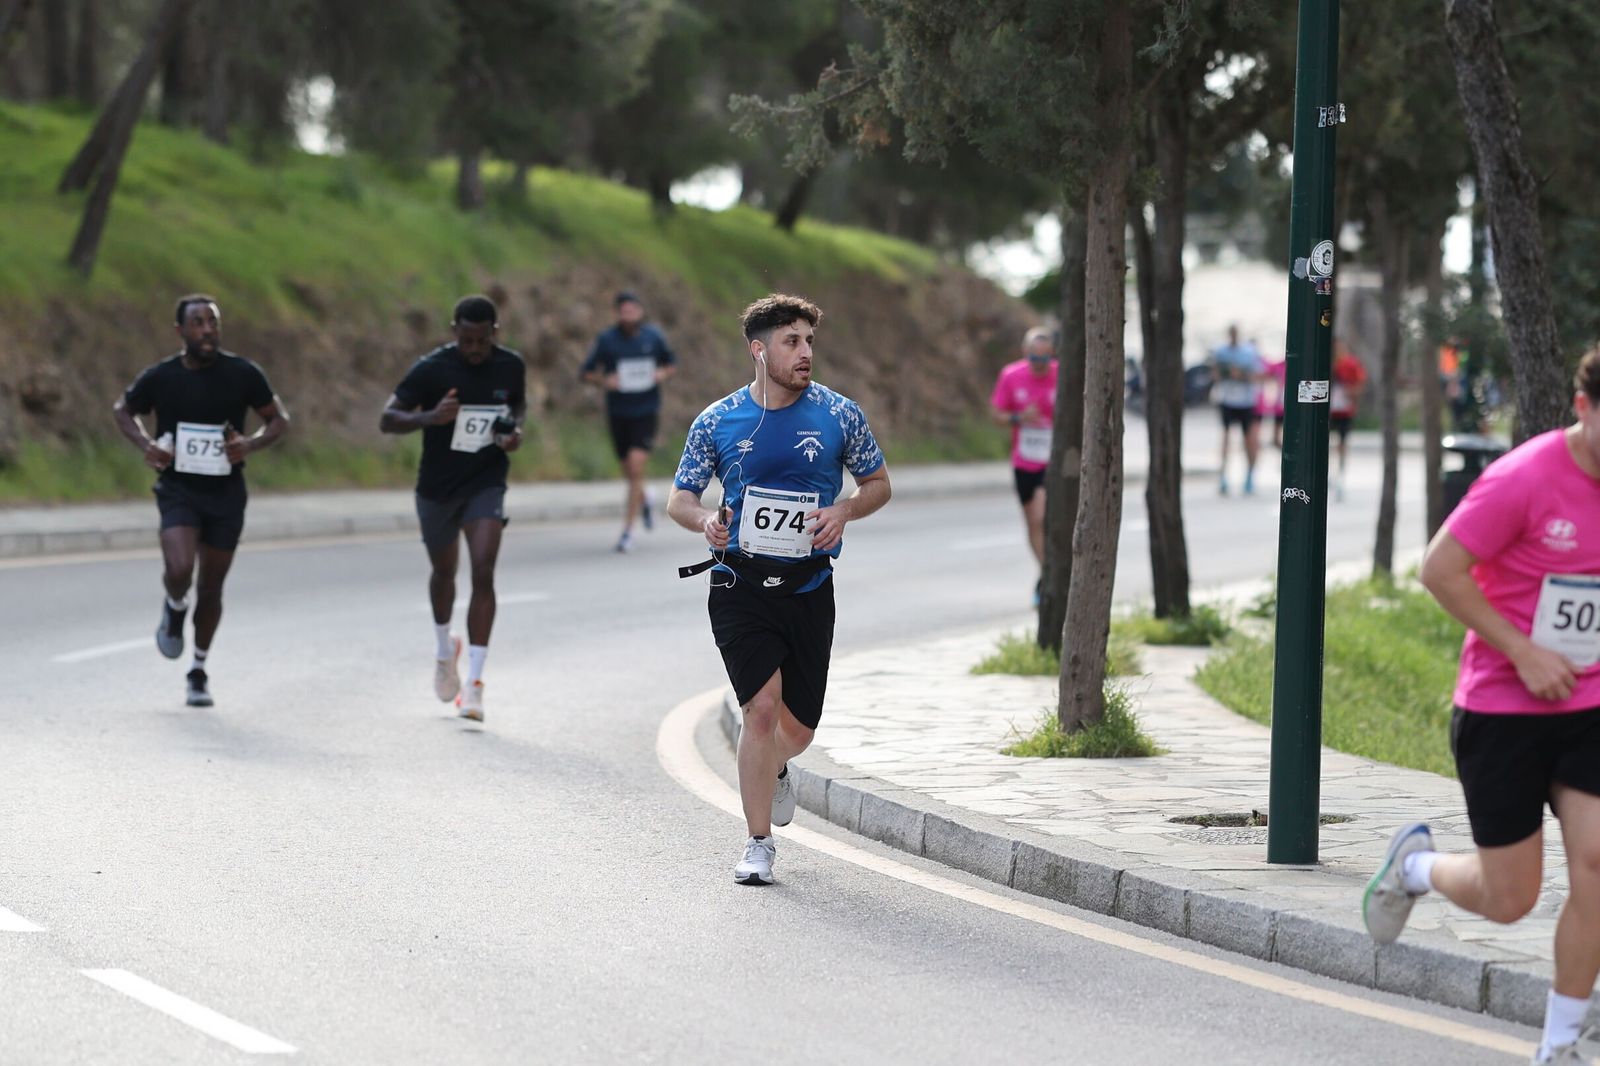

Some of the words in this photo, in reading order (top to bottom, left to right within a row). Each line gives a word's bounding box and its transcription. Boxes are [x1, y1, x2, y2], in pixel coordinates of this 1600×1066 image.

[465, 417, 489, 434] 67
[186, 438, 225, 457] 675
[754, 506, 806, 534] 674
[1553, 600, 1600, 633] 50
